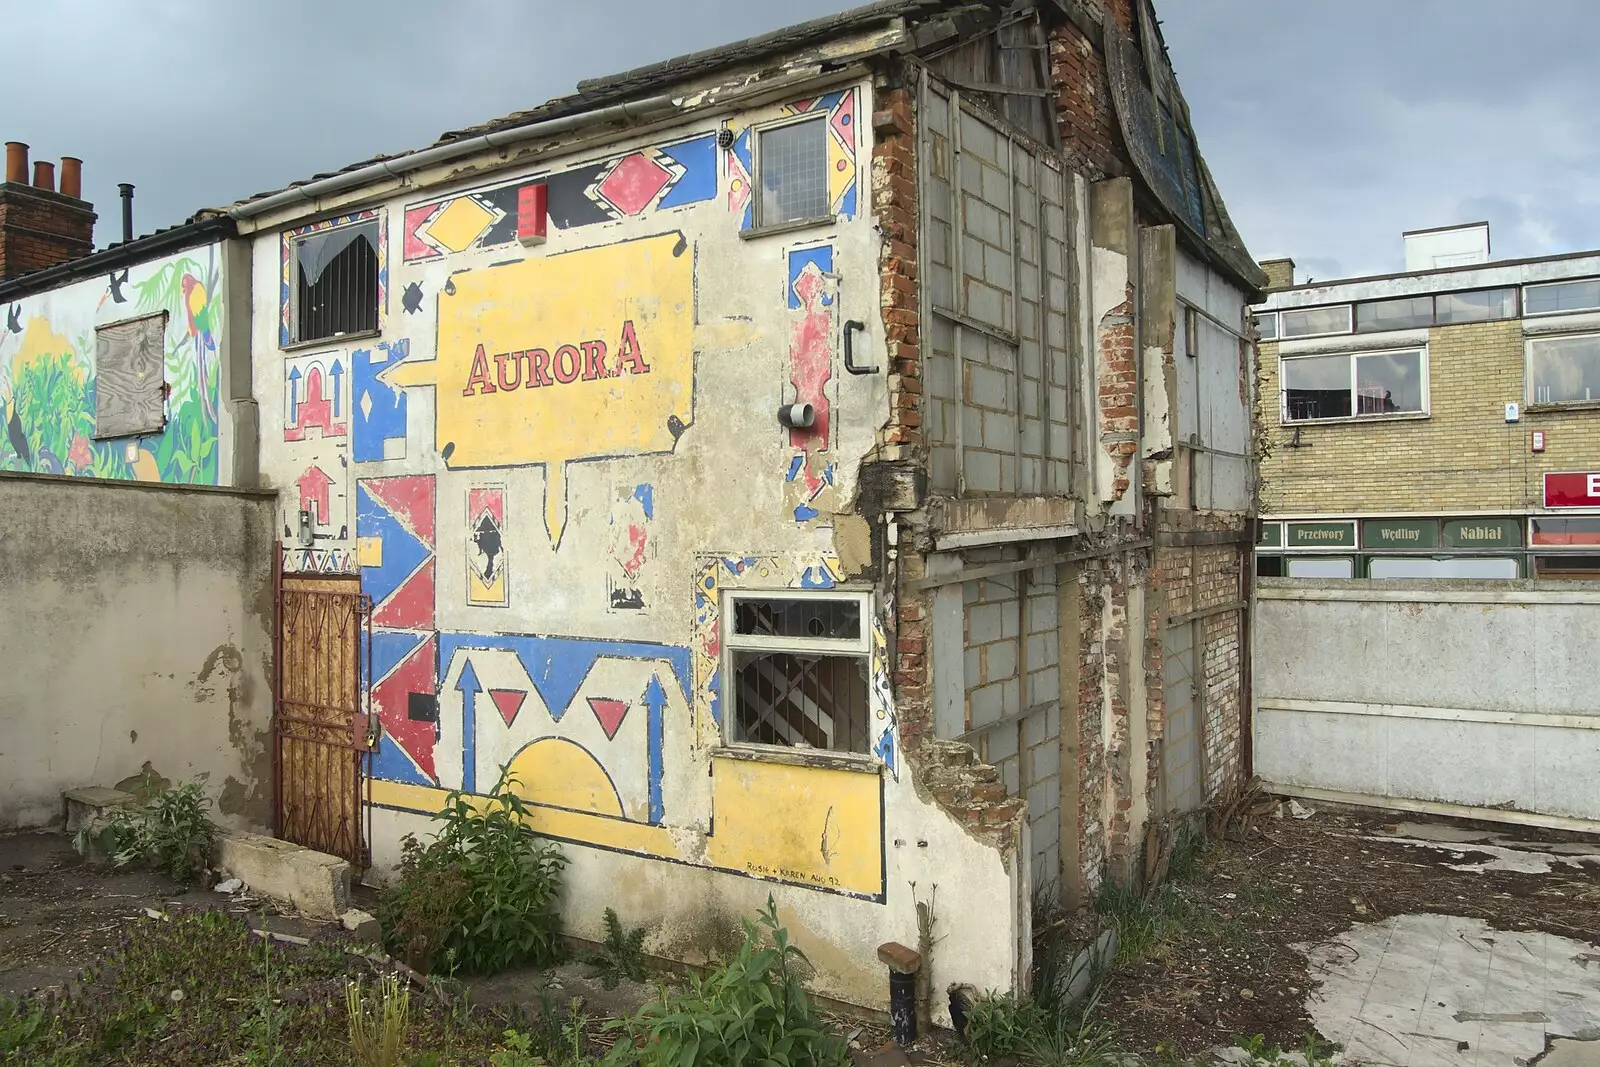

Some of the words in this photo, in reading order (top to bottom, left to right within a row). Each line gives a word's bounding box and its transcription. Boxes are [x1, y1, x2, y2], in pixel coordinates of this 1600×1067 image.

[463, 319, 650, 396] AURORA
[1381, 529, 1420, 541] Wędliny
[1460, 527, 1502, 540] Nabiał
[779, 867, 805, 879] KAREN
[828, 876, 841, 887] 92
